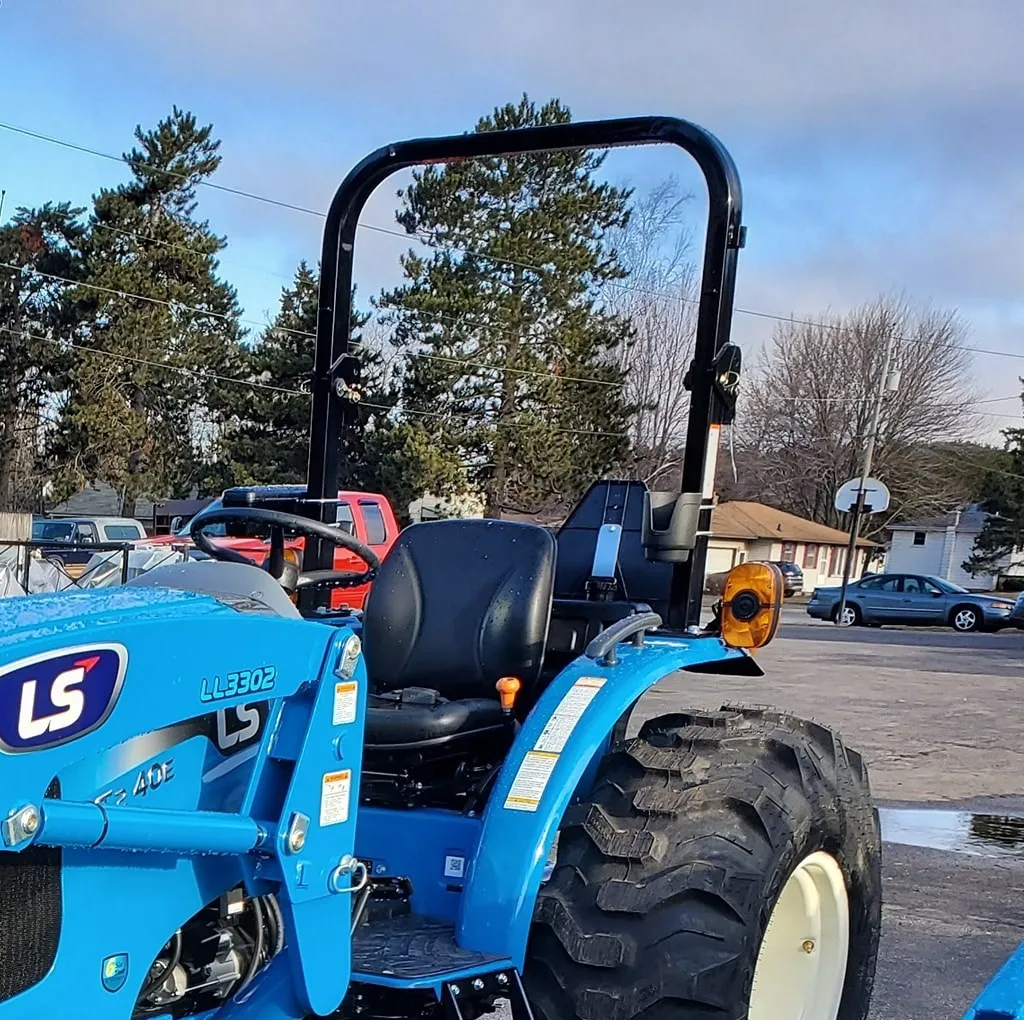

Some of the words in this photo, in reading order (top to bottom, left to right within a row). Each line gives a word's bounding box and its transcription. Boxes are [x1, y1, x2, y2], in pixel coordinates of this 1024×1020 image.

[18, 667, 85, 740] LS
[200, 666, 276, 702] LL3302
[216, 703, 260, 750] LS
[133, 757, 176, 797] 40E
